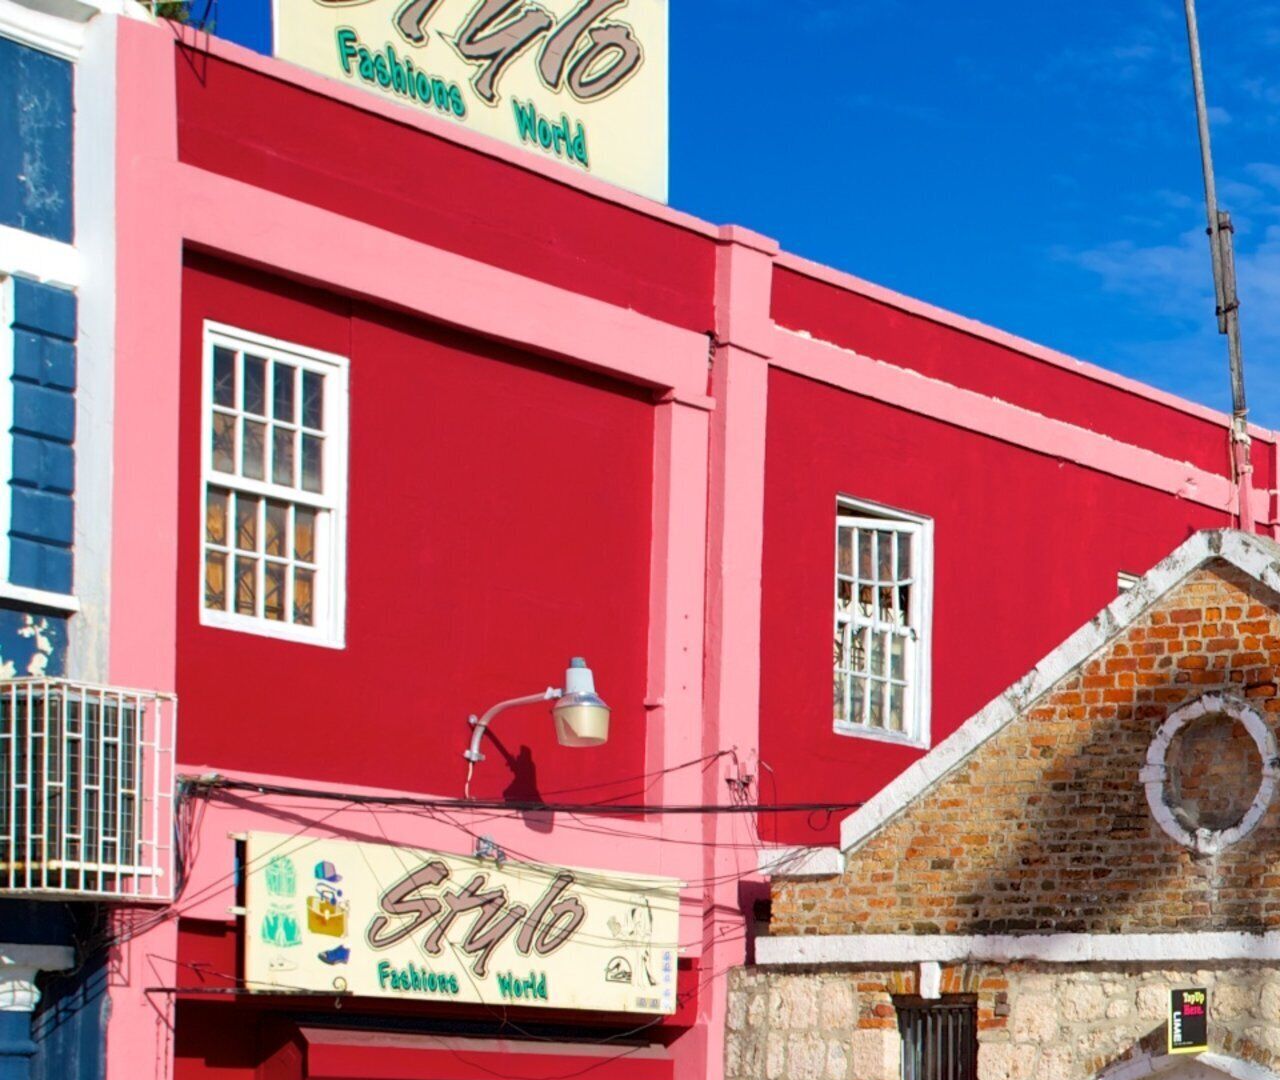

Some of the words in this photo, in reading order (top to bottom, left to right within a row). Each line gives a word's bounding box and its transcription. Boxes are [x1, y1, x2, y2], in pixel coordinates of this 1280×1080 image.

[337, 27, 467, 118] Fashions
[511, 97, 590, 169] World
[366, 860, 586, 978] Stylo
[376, 961, 460, 995] Fashions
[497, 971, 548, 1000] World
[1173, 1011, 1182, 1042] LIME
